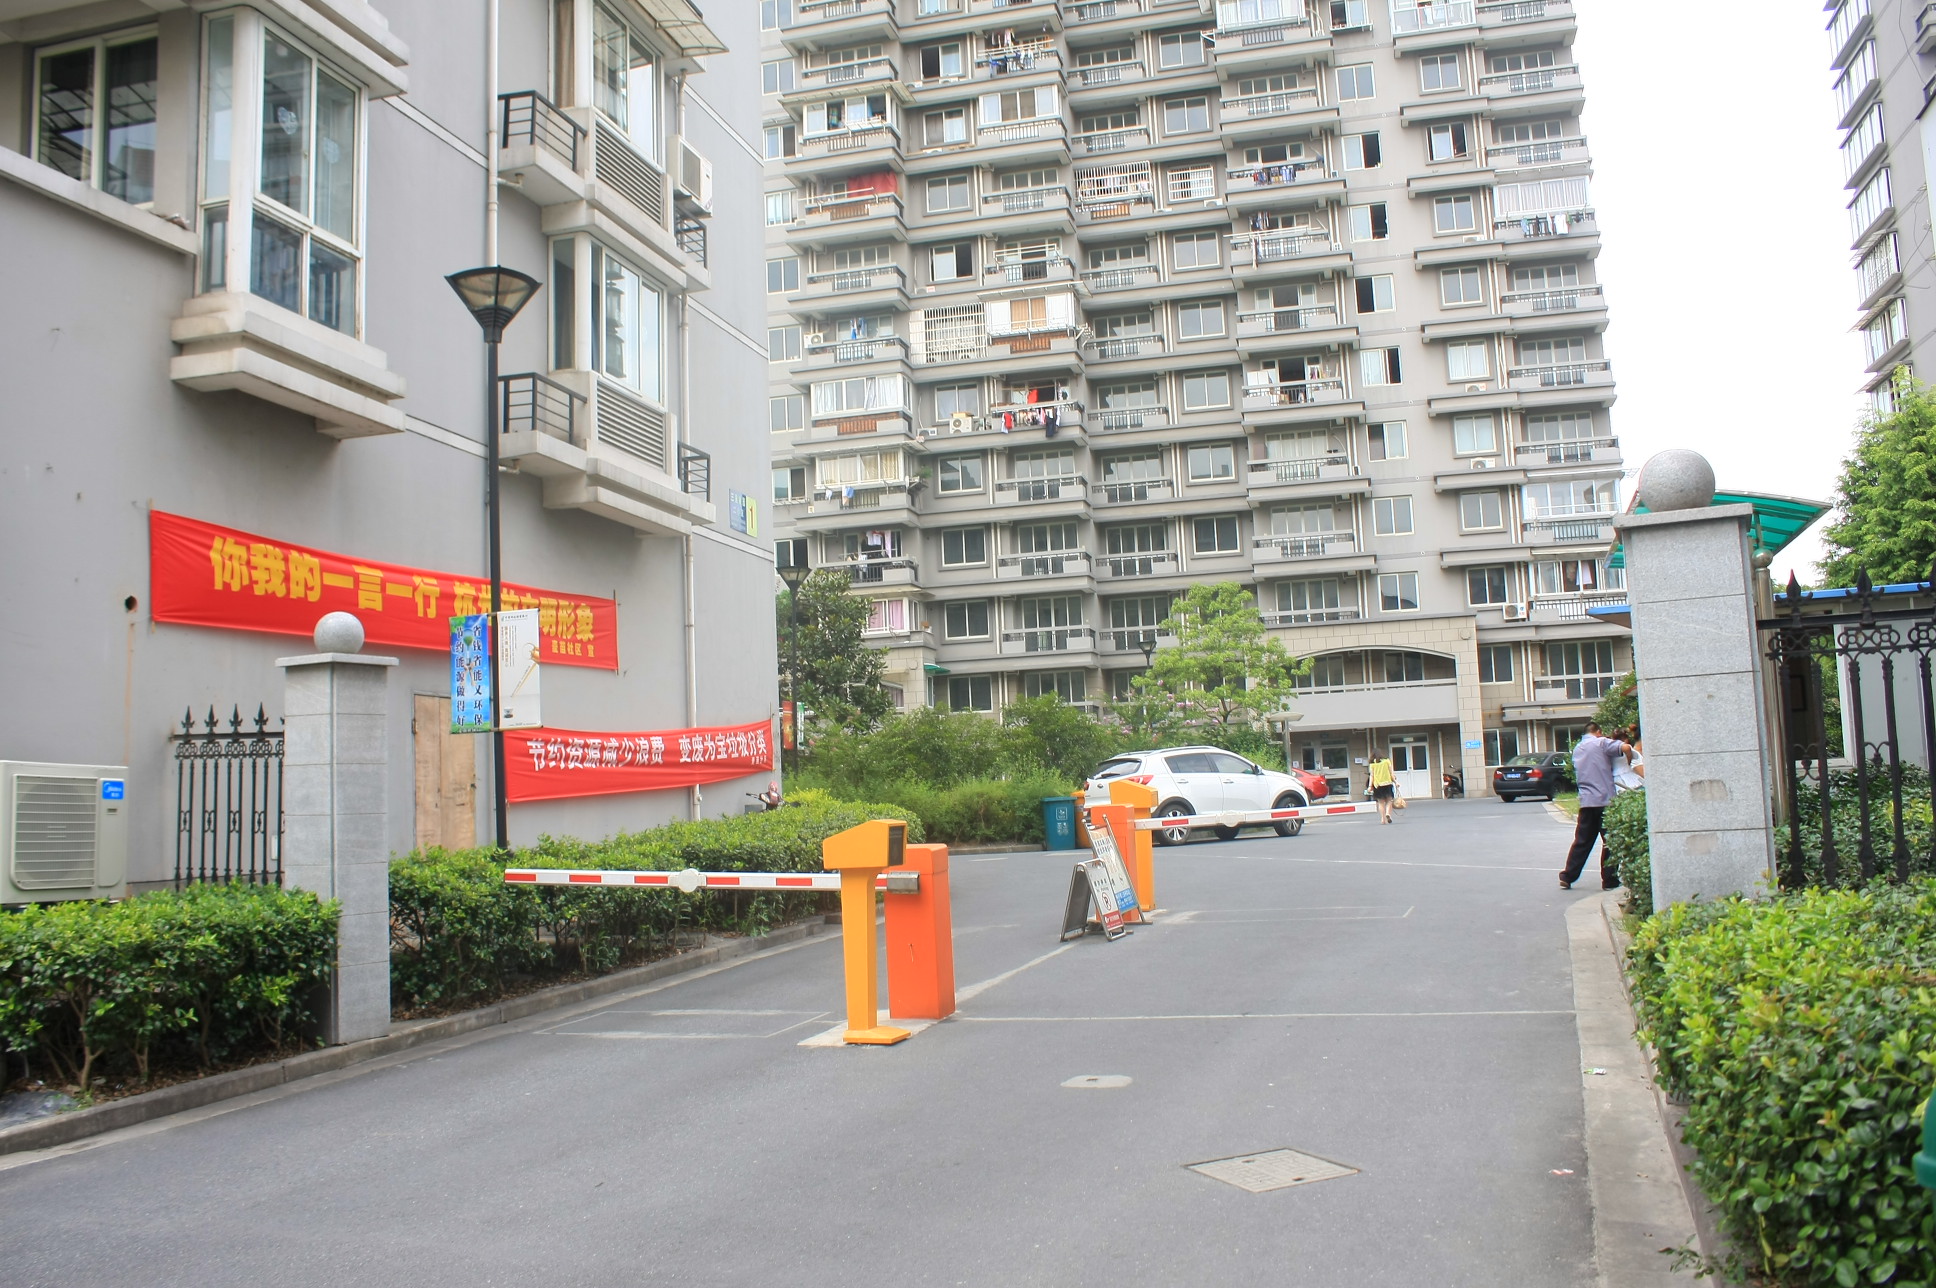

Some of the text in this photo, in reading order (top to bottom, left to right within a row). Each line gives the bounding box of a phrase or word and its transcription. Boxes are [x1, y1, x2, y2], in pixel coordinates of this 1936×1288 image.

[209, 535, 441, 619] 你我的一言一行
[455, 625, 466, 727] 节约能源做得好
[472, 624, 483, 726] 省钱省能又环保
[526, 729, 767, 772] 节约资源减少浪费 变废为宝垃圾分类
